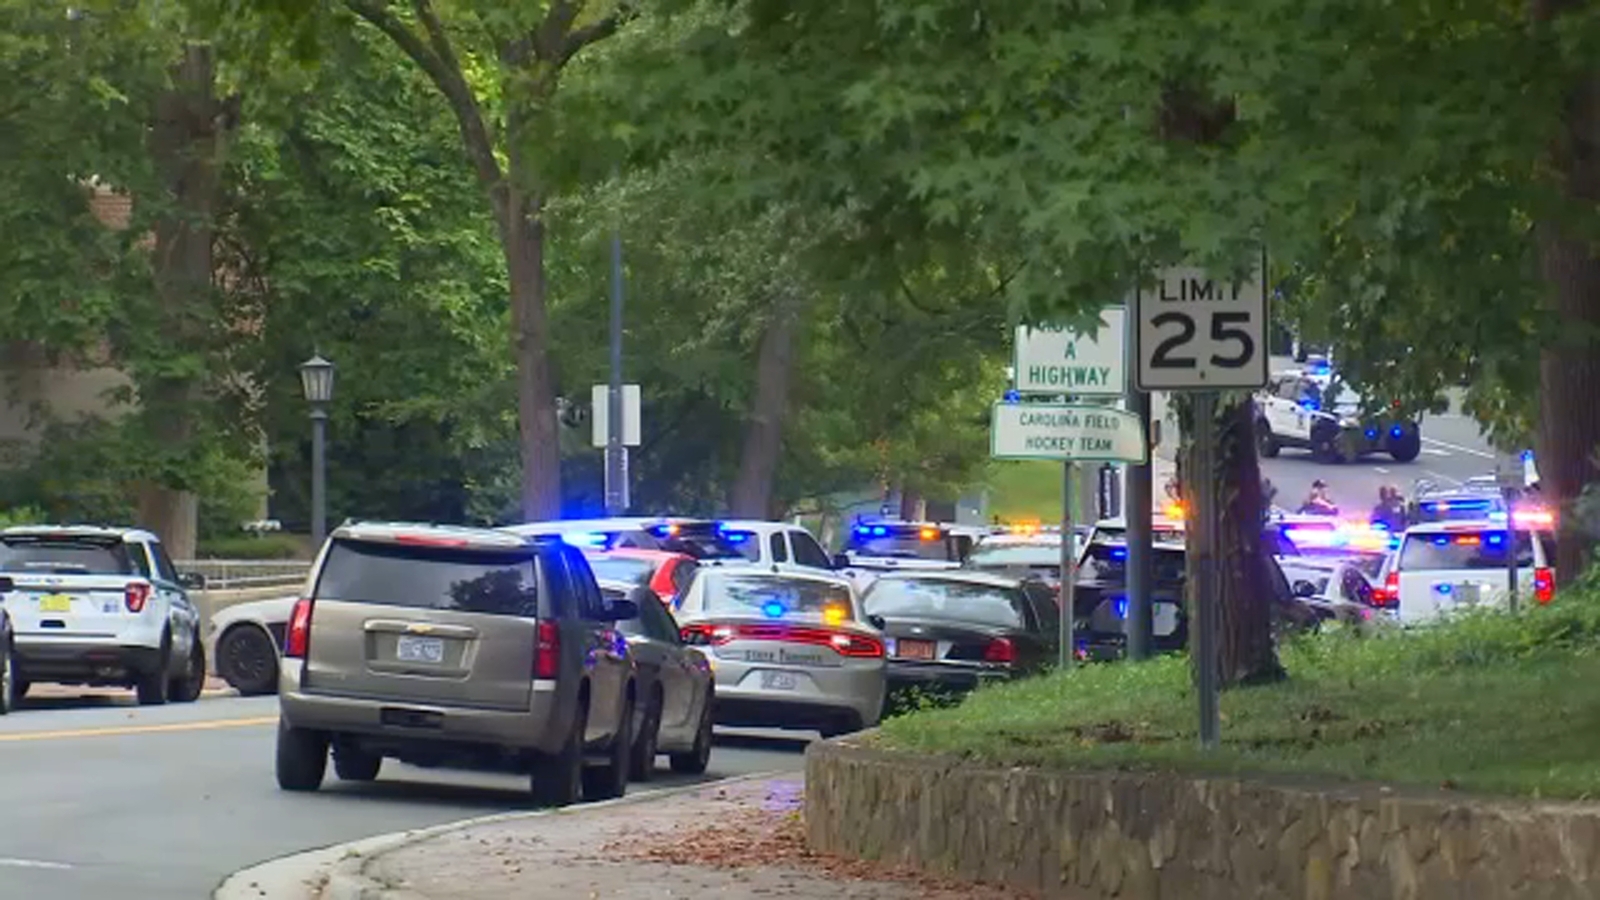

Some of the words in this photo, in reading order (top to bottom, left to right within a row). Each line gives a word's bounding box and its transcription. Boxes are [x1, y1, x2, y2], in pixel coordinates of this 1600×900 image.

[1150, 312, 1254, 368] 25
[1064, 341, 1076, 360] A
[1029, 366, 1110, 386] HIGHWAY
[1019, 412, 1080, 427] CAROLINA
[1084, 414, 1120, 430] FIELD
[1025, 436, 1075, 450] HOCKEY
[1080, 437, 1113, 451] TEAM
